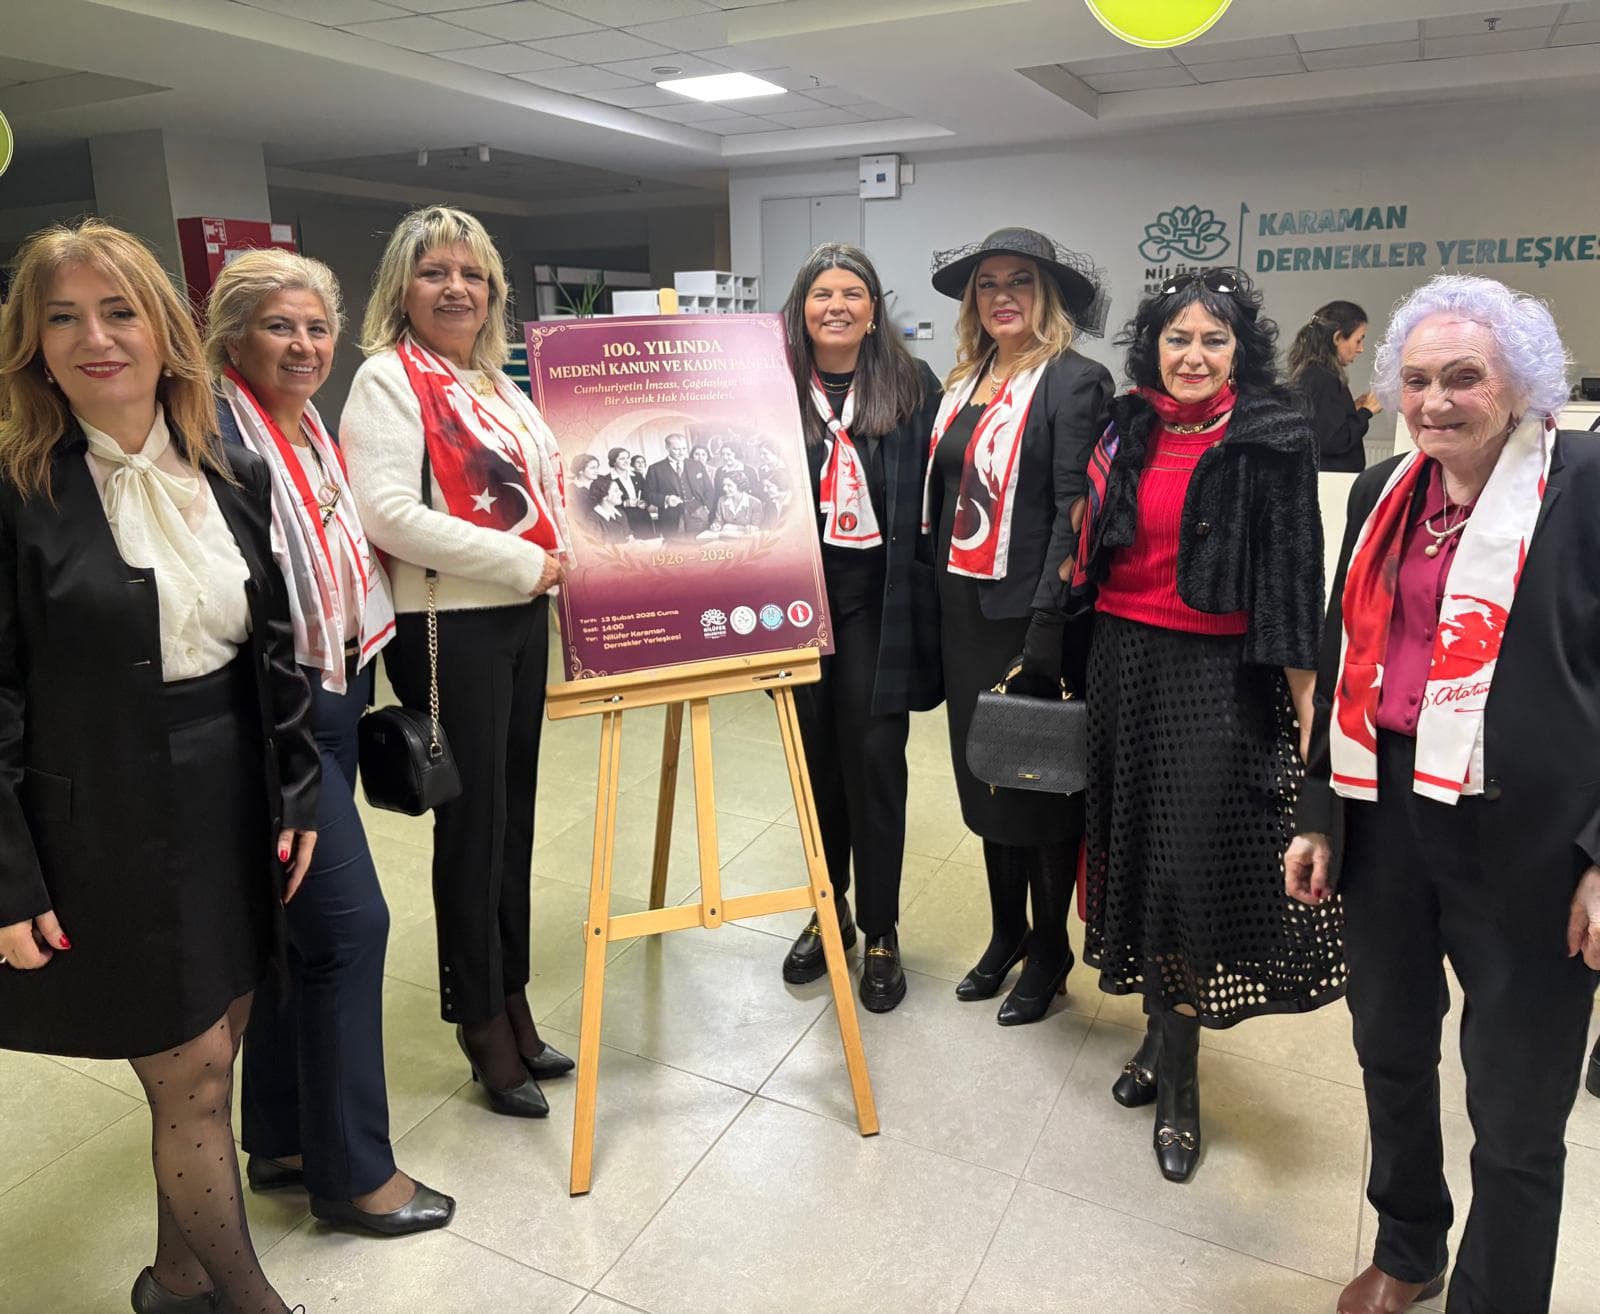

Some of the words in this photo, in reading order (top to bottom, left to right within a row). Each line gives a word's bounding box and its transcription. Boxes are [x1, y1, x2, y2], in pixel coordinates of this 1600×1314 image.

[1258, 205, 1408, 237] KARAMAN
[1256, 241, 1427, 273] DERNEKLER
[1436, 234, 1600, 269] YERLEŞKE
[602, 342, 641, 358] 100.
[644, 339, 723, 357] YILINDA
[549, 360, 606, 379] MEDENİ
[609, 360, 660, 376] KANUN
[663, 360, 682, 373] VE
[684, 358, 727, 371] KADIN
[574, 381, 643, 395] Cumhuriyetin
[604, 396, 620, 406] Bir
[622, 394, 654, 405] Asırlık
[657, 392, 678, 403] Hak
[652, 552, 684, 567] 1926
[700, 548, 735, 561] 2026
[631, 628, 666, 638] Karaman
